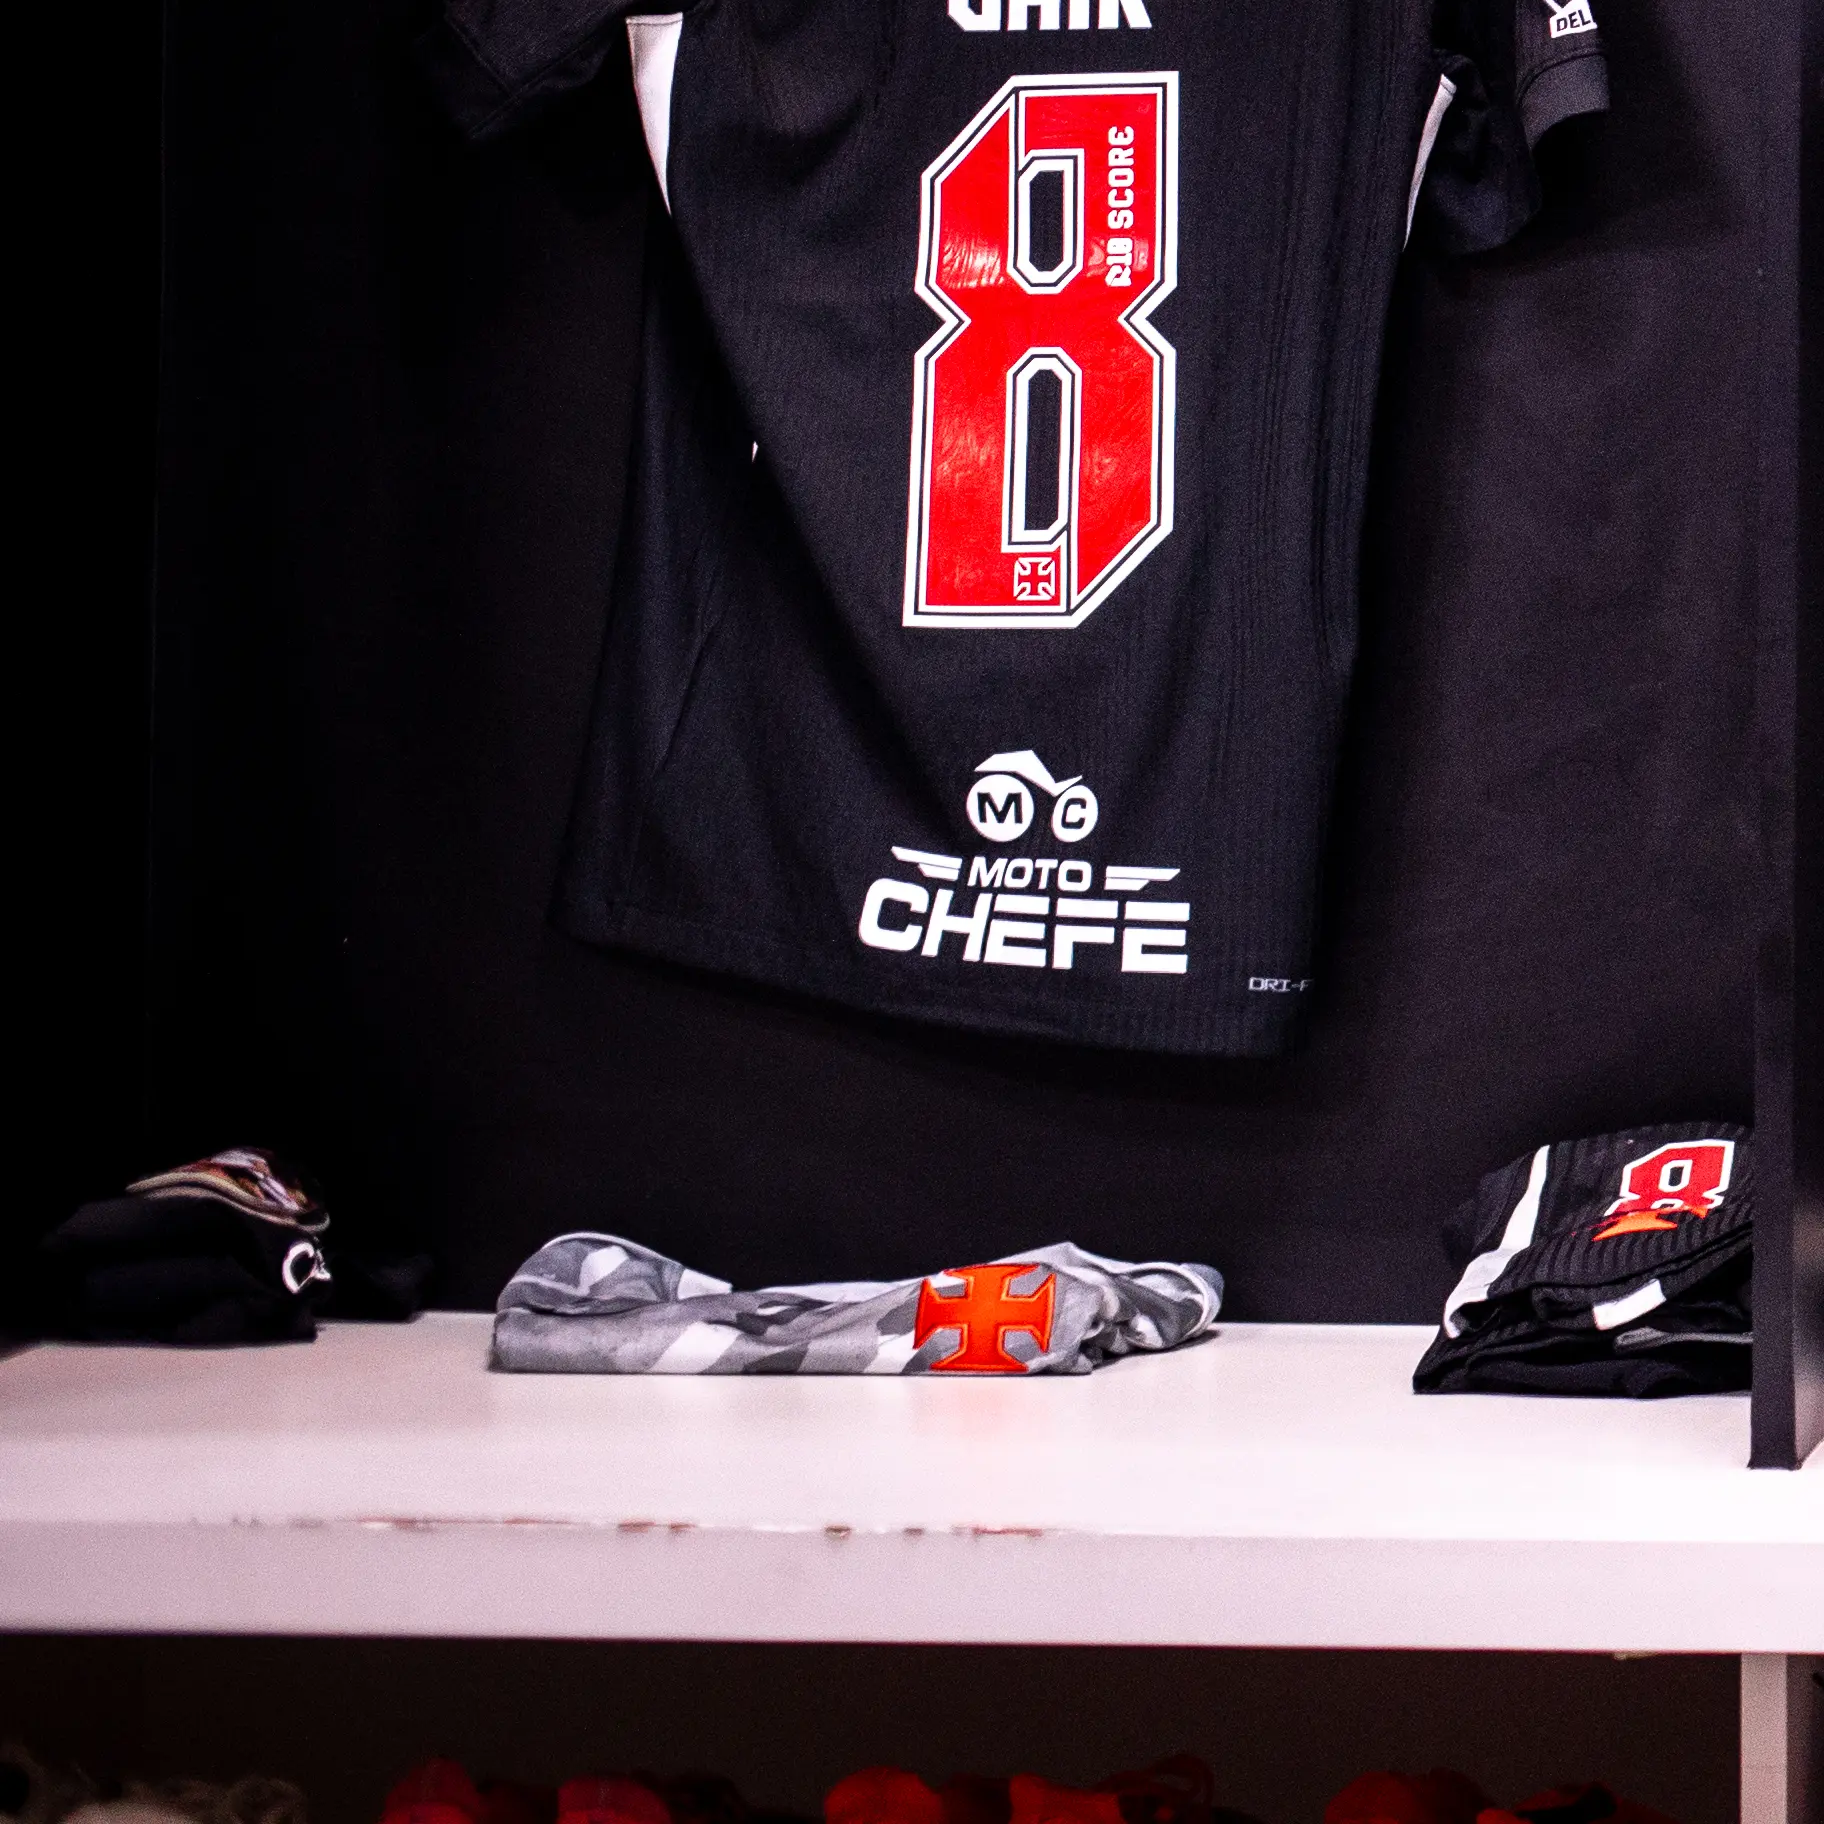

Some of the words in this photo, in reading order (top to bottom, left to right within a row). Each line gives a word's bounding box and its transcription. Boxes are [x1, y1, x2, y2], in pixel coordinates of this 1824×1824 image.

[1107, 125, 1135, 230] SCORE
[902, 70, 1180, 630] 8
[966, 856, 1093, 892] MOTO
[858, 877, 1191, 975] CHEFE
